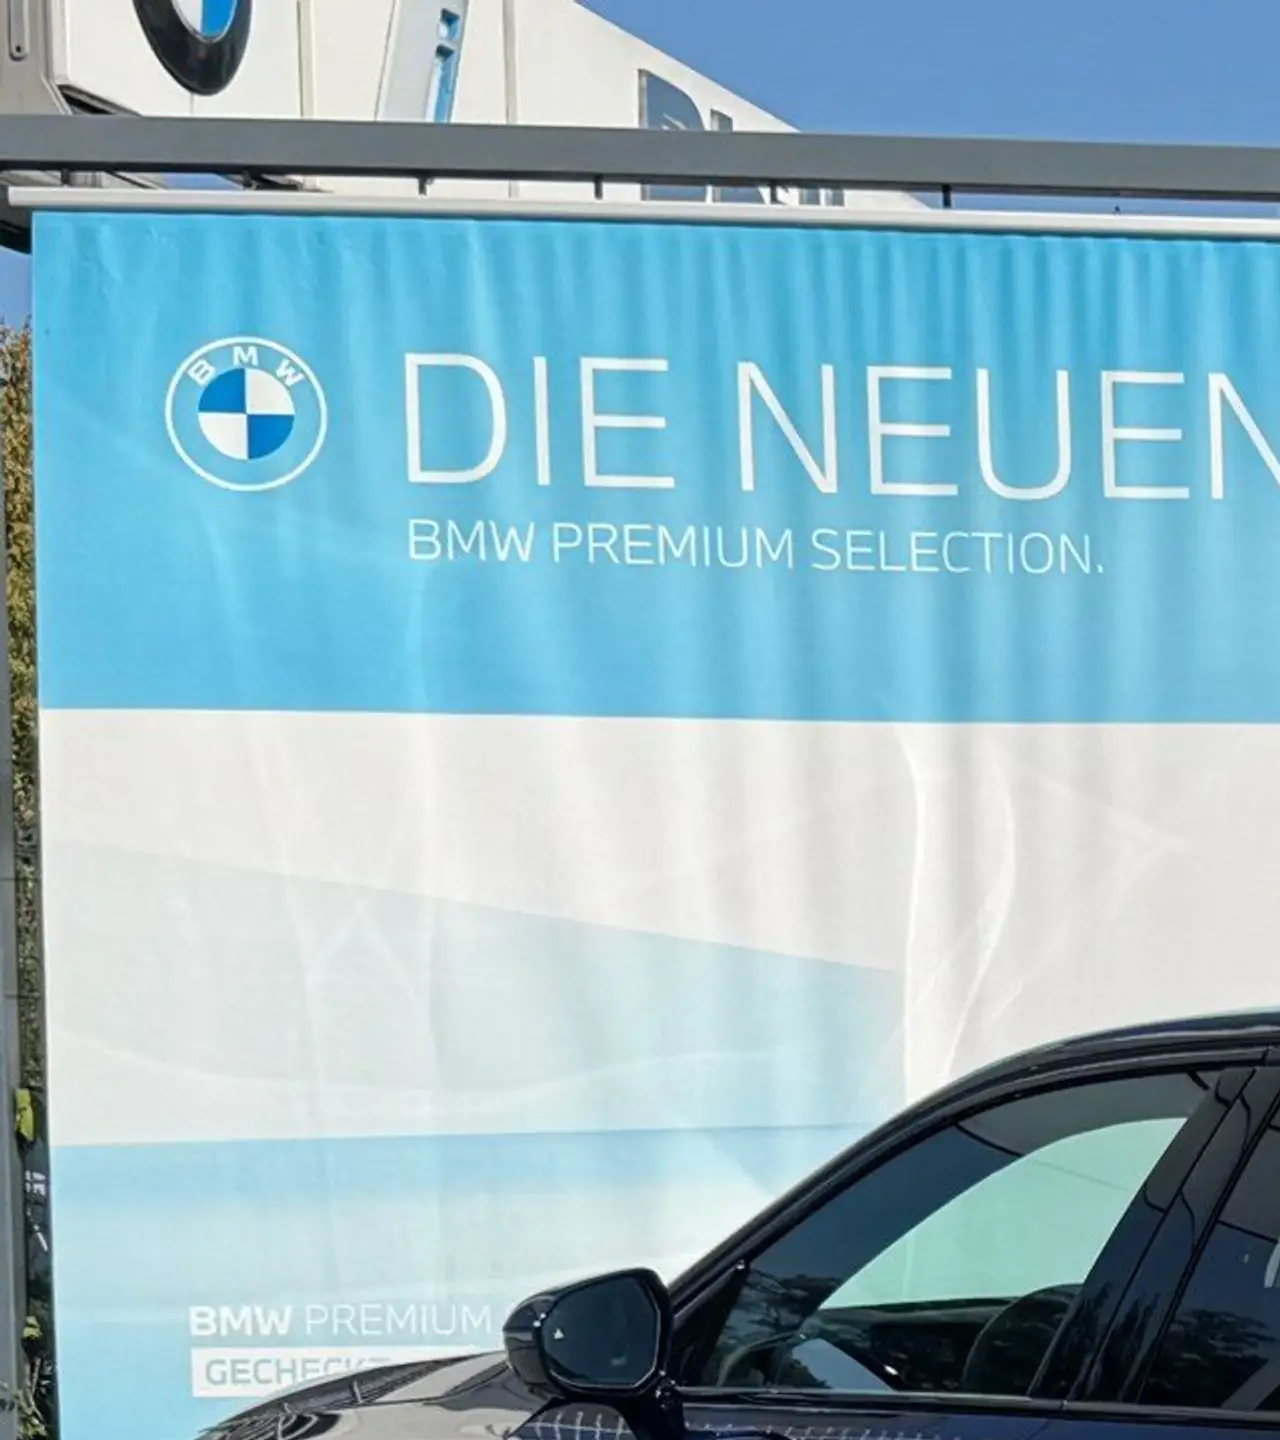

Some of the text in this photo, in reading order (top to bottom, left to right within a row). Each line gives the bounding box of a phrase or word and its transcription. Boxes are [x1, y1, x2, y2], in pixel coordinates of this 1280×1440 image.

[187, 345, 305, 388] BMW
[404, 352, 675, 490] DIE
[407, 518, 1105, 575] BMW PREMIUM SELECTION.
[189, 1304, 293, 1337] BMW
[305, 1303, 491, 1336] PREMIUM
[206, 1358, 391, 1386] GECHEC
